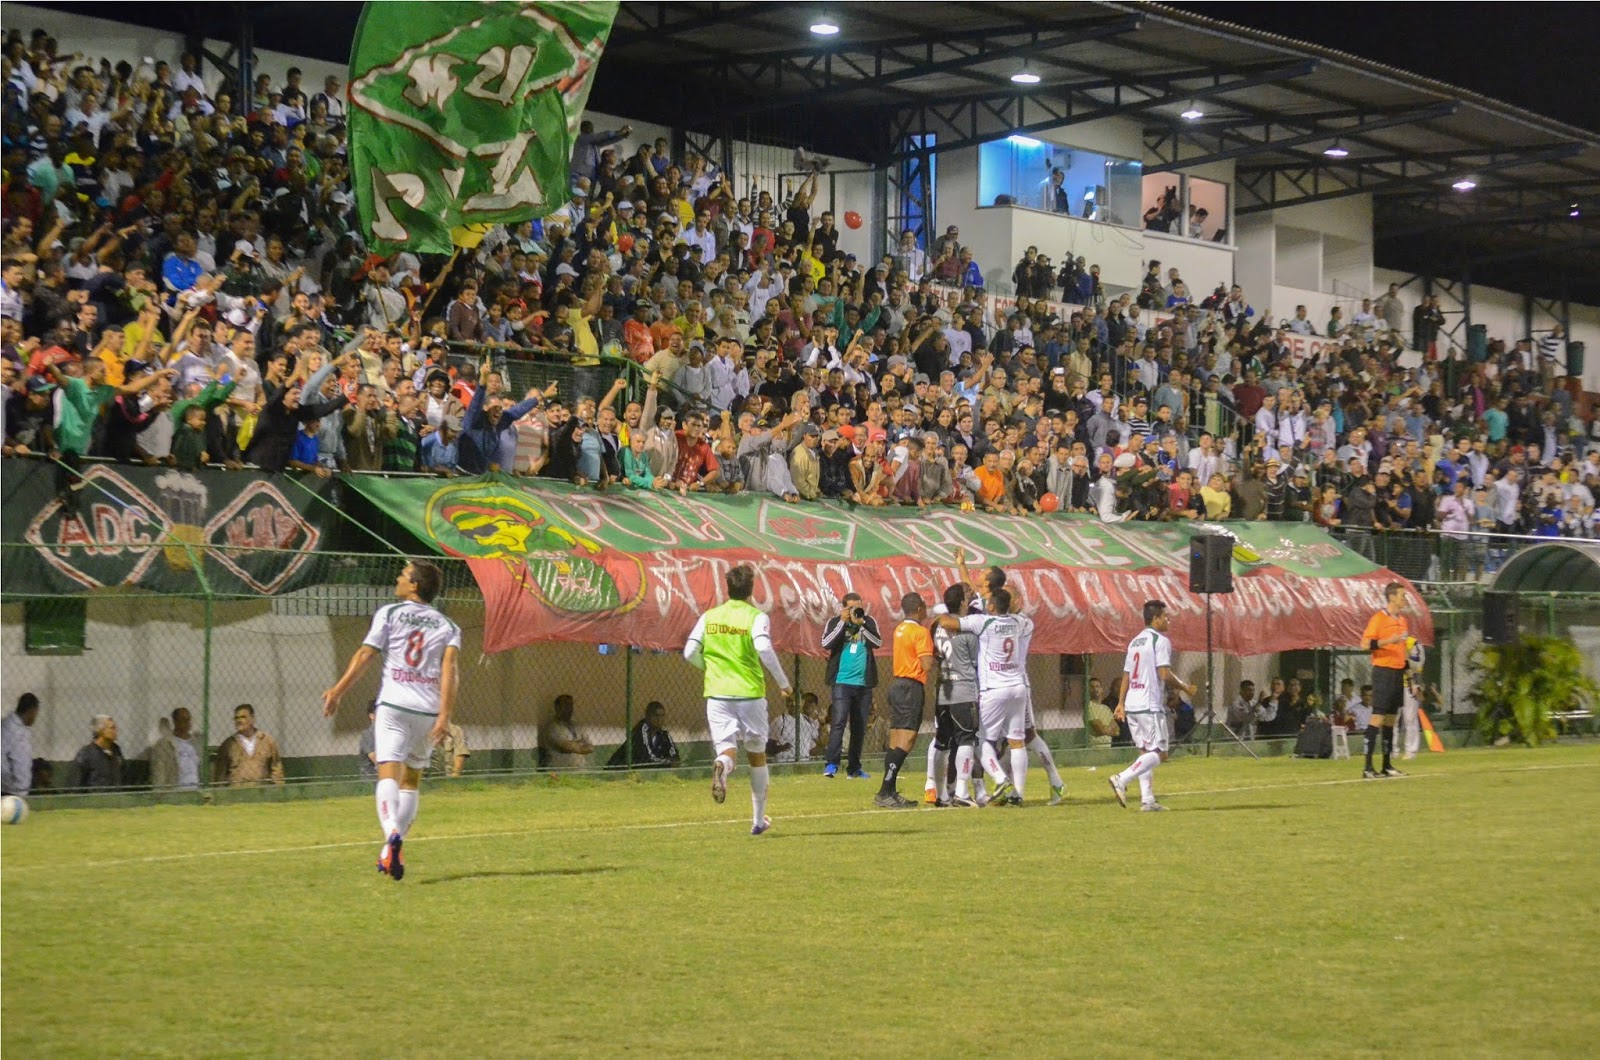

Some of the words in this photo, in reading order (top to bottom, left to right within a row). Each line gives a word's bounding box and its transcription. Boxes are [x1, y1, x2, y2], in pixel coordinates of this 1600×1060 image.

[57, 503, 152, 557] ADC
[405, 629, 424, 667] 8
[1003, 637, 1014, 663] 9
[1132, 651, 1140, 680] 2
